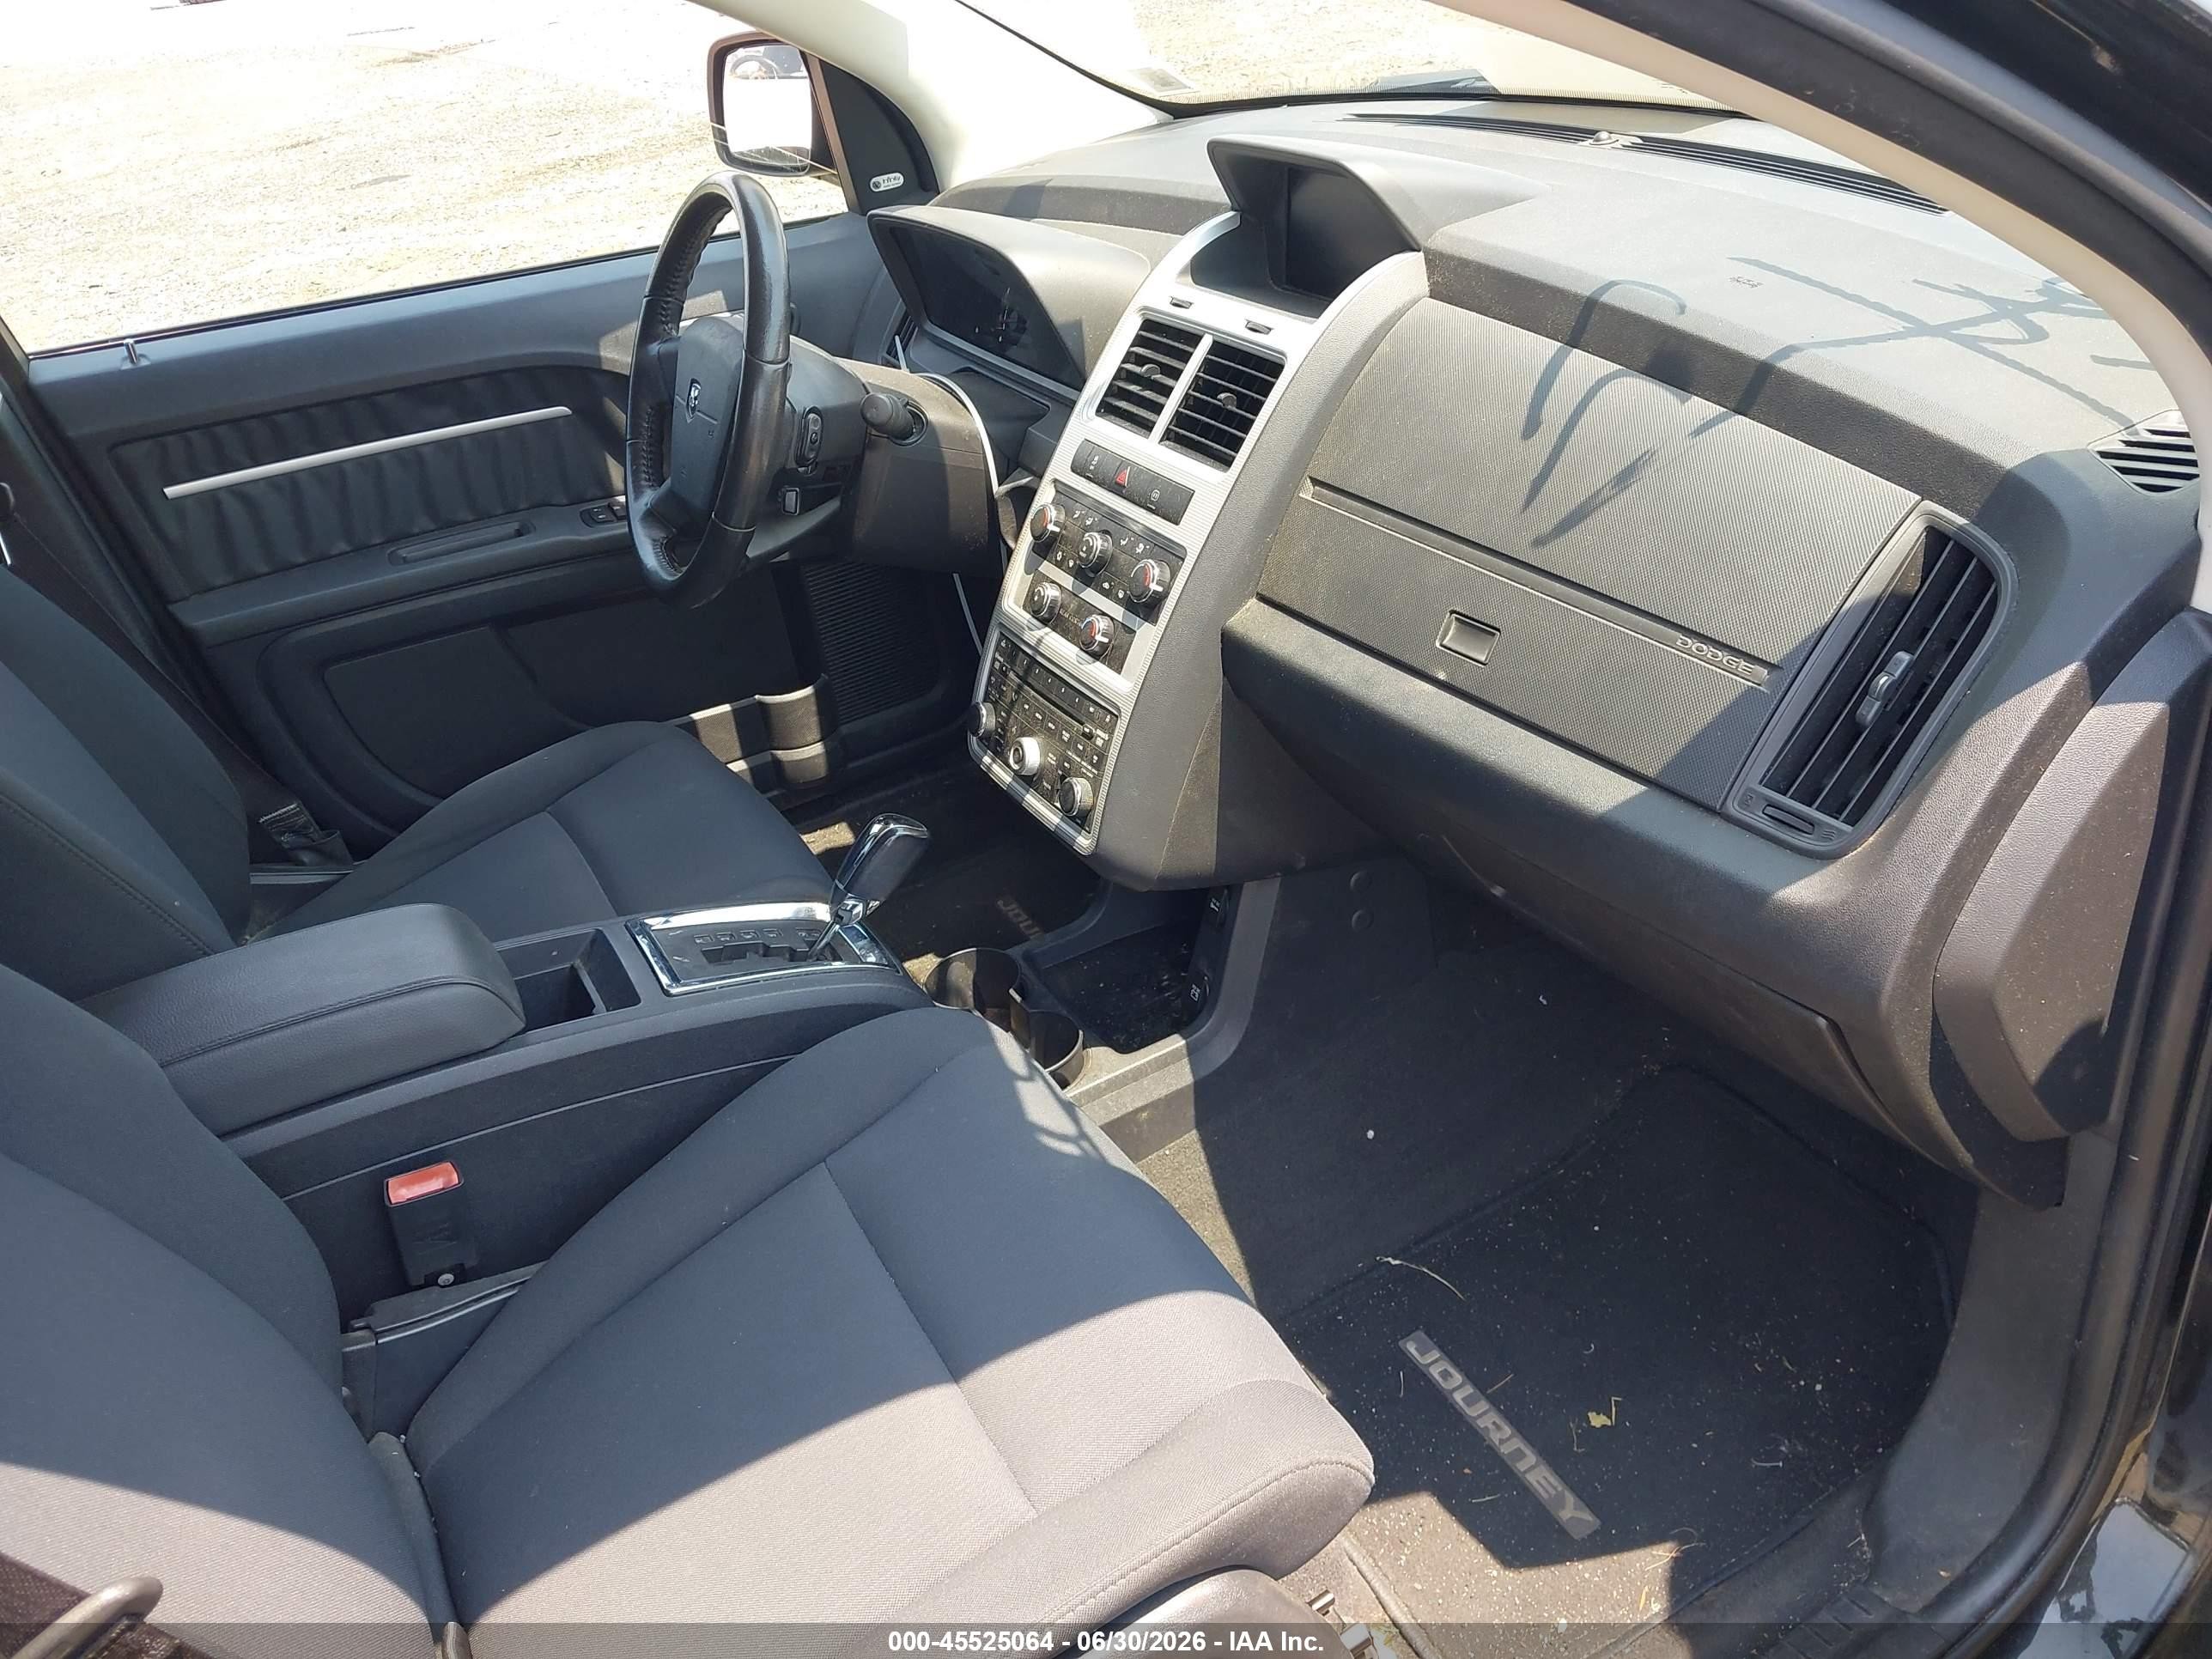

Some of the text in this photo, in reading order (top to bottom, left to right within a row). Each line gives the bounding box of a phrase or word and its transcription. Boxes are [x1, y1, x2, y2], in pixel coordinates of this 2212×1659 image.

[1676, 635, 1755, 675] DODGE
[996, 898, 1042, 940] JOU
[1406, 1340, 1595, 1522] JOURNEY
